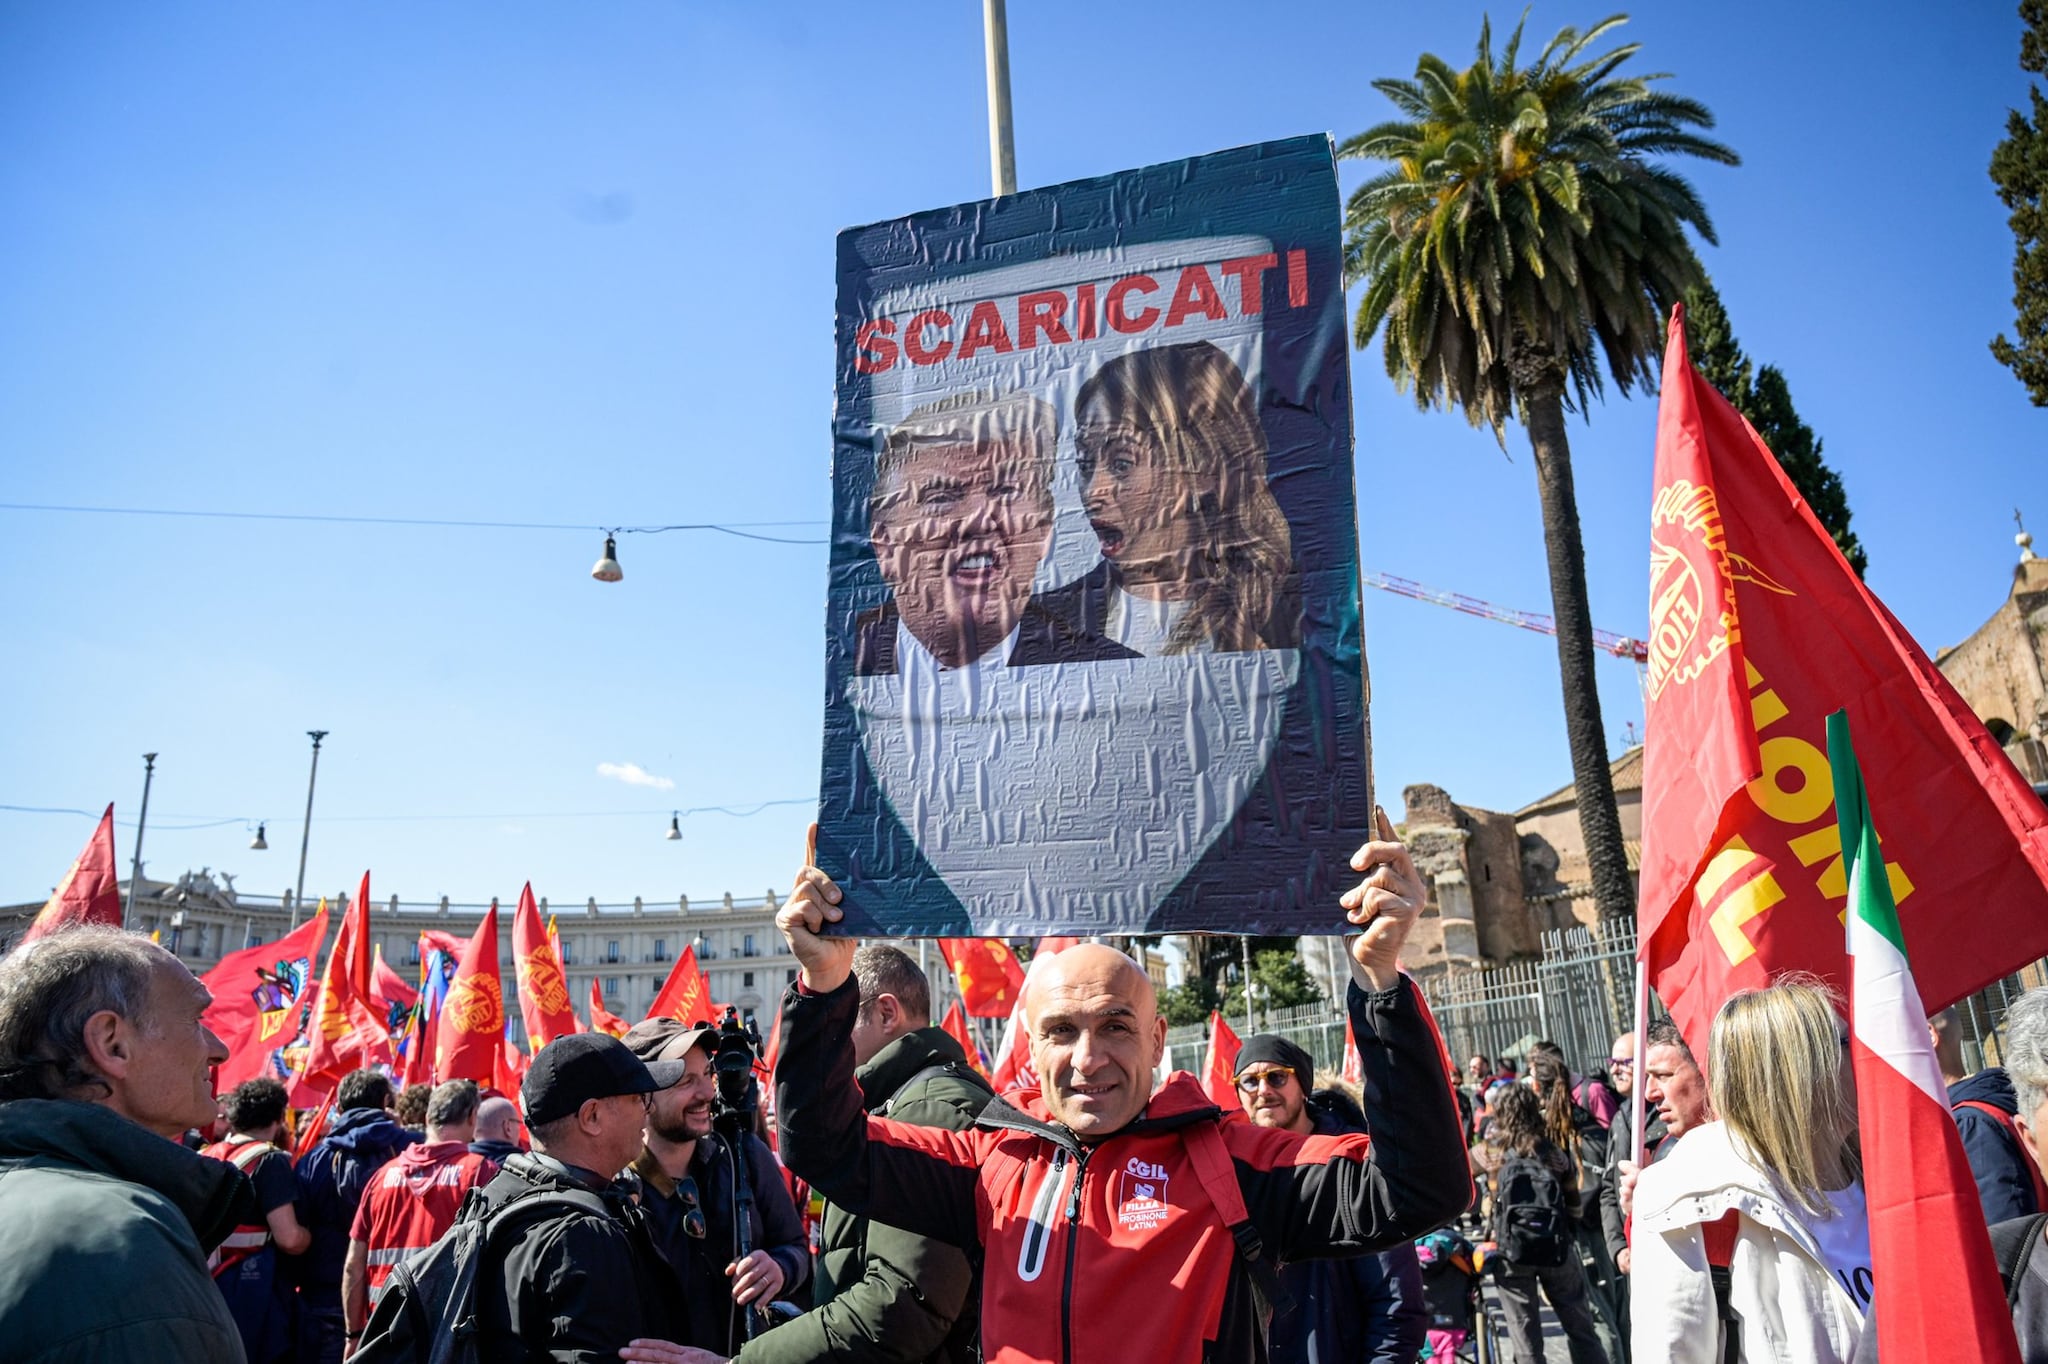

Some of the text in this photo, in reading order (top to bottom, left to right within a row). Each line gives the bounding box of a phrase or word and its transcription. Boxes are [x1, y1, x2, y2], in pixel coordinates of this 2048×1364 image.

[853, 249, 1309, 374] SCARICATI
[1127, 1157, 1168, 1178] CGIL
[1126, 1201, 1159, 1211] FILLEA
[1120, 1212, 1167, 1224] FROSINONE
[1128, 1221, 1158, 1231] LATINA
